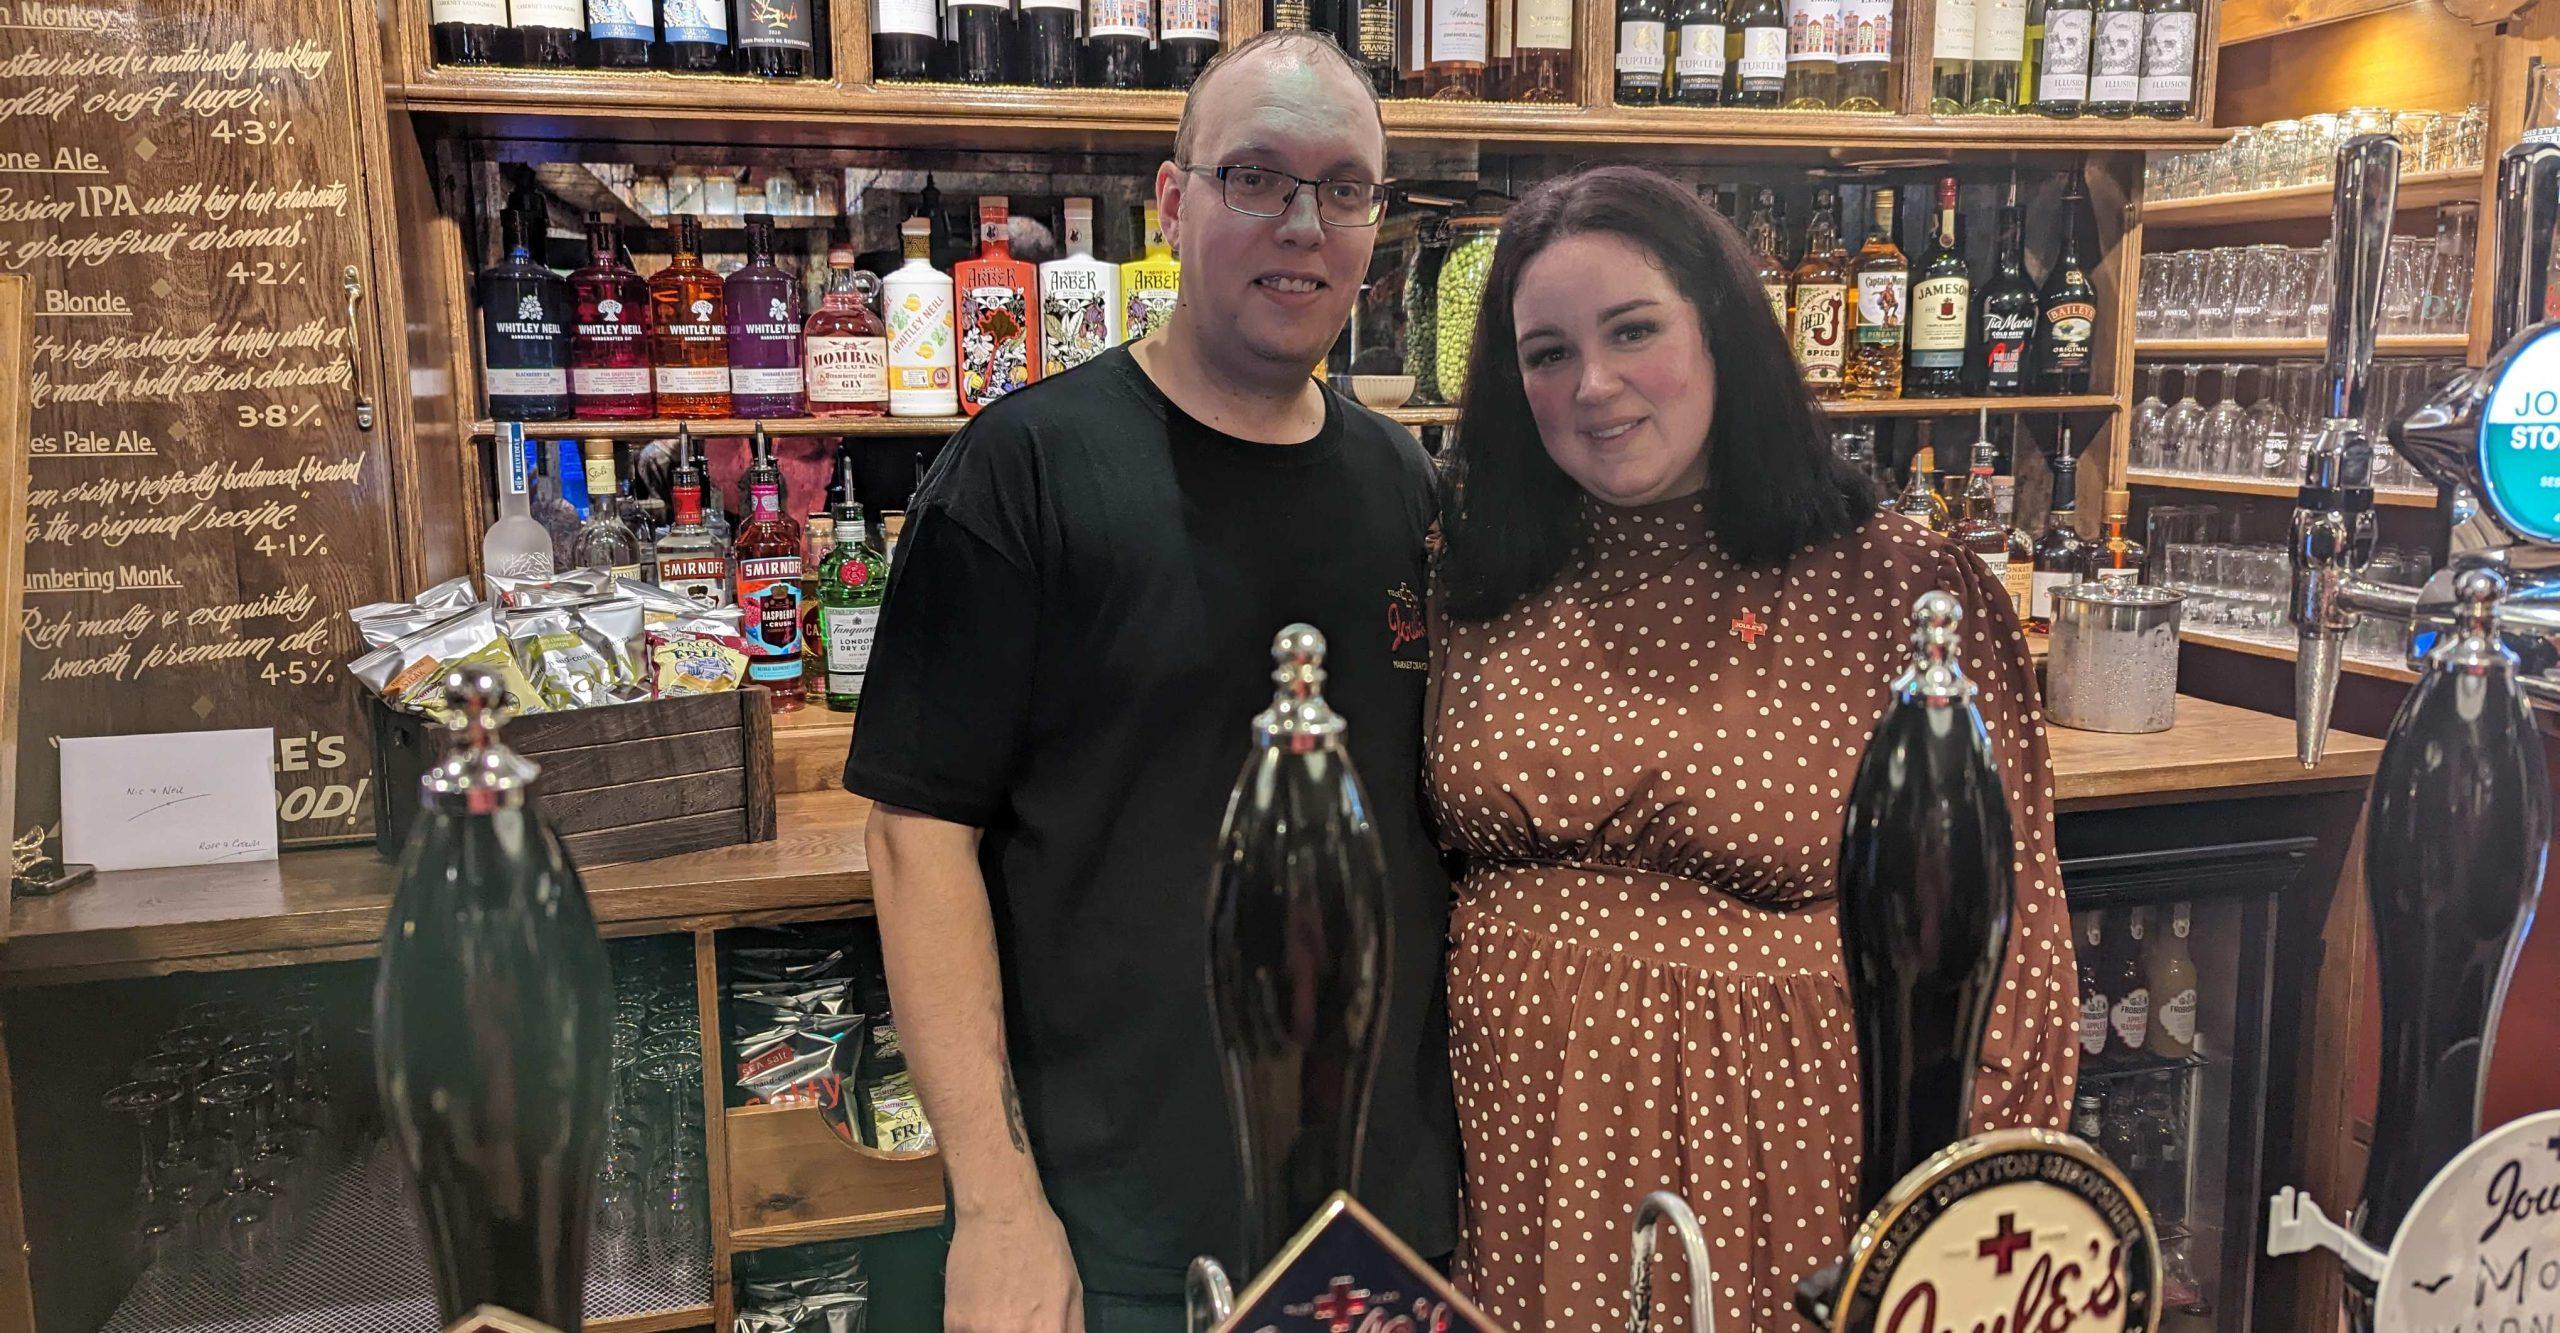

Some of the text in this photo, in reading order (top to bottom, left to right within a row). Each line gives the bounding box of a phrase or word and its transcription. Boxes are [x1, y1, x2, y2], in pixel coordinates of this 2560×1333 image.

[1360, 44, 1391, 52] ORANGE
[150, 40, 252, 81] naturally
[249, 39, 332, 80] sparkling
[83, 82, 178, 122] craft
[54, 147, 108, 170] Ale.
[77, 185, 139, 217] IPA
[141, 182, 202, 216] with
[203, 184, 239, 220] big
[240, 180, 276, 217] hop
[274, 179, 348, 217] character
[6, 221, 188, 270] grapefruit
[968, 268, 1016, 288] ARBER
[1051, 271, 1096, 290] ARBER
[46, 289, 131, 312] Blonde.
[1983, 313, 2033, 331] Tia Maria
[2051, 306, 2094, 319] BAILEYS
[496, 322, 561, 334] WHITLEY NEILL
[578, 324, 642, 335] WHITLEY NEILL
[670, 325, 710, 335] WHITLEY
[746, 324, 786, 334] WHITLEY
[893, 296, 945, 354] WHITLEY NEILL
[62, 322, 222, 369] refreshingly
[221, 321, 280, 359] hoppy
[278, 316, 326, 351] with
[324, 327, 346, 348] a
[1807, 349, 1840, 357] SPICED
[813, 351, 884, 368] MOMBASA
[53, 370, 119, 406] malt
[131, 364, 189, 402] bold
[183, 364, 254, 393] citrus
[253, 352, 352, 390] character
[842, 380, 862, 388] GIN
[64, 430, 110, 453] Pale
[115, 430, 157, 453] Ale.
[62, 477, 118, 507] crisp
[131, 460, 222, 505] perfectly
[302, 451, 366, 485] brewed
[42, 511, 80, 546] the
[80, 502, 204, 547] original
[120, 565, 181, 587] Monk.
[664, 561, 724, 577] SMIRNOFF
[22, 606, 72, 650] Rich
[77, 603, 155, 640] malty
[187, 584, 317, 633] exquisitely
[762, 609, 796, 621] RASPBERRY
[41, 643, 132, 681] smooth
[133, 633, 275, 681] premium
[400, 669, 426, 688] STEAK
[743, 1051, 787, 1075] SEA salt
[896, 1108, 918, 1124] SCA
[892, 1121, 922, 1143] FRI
